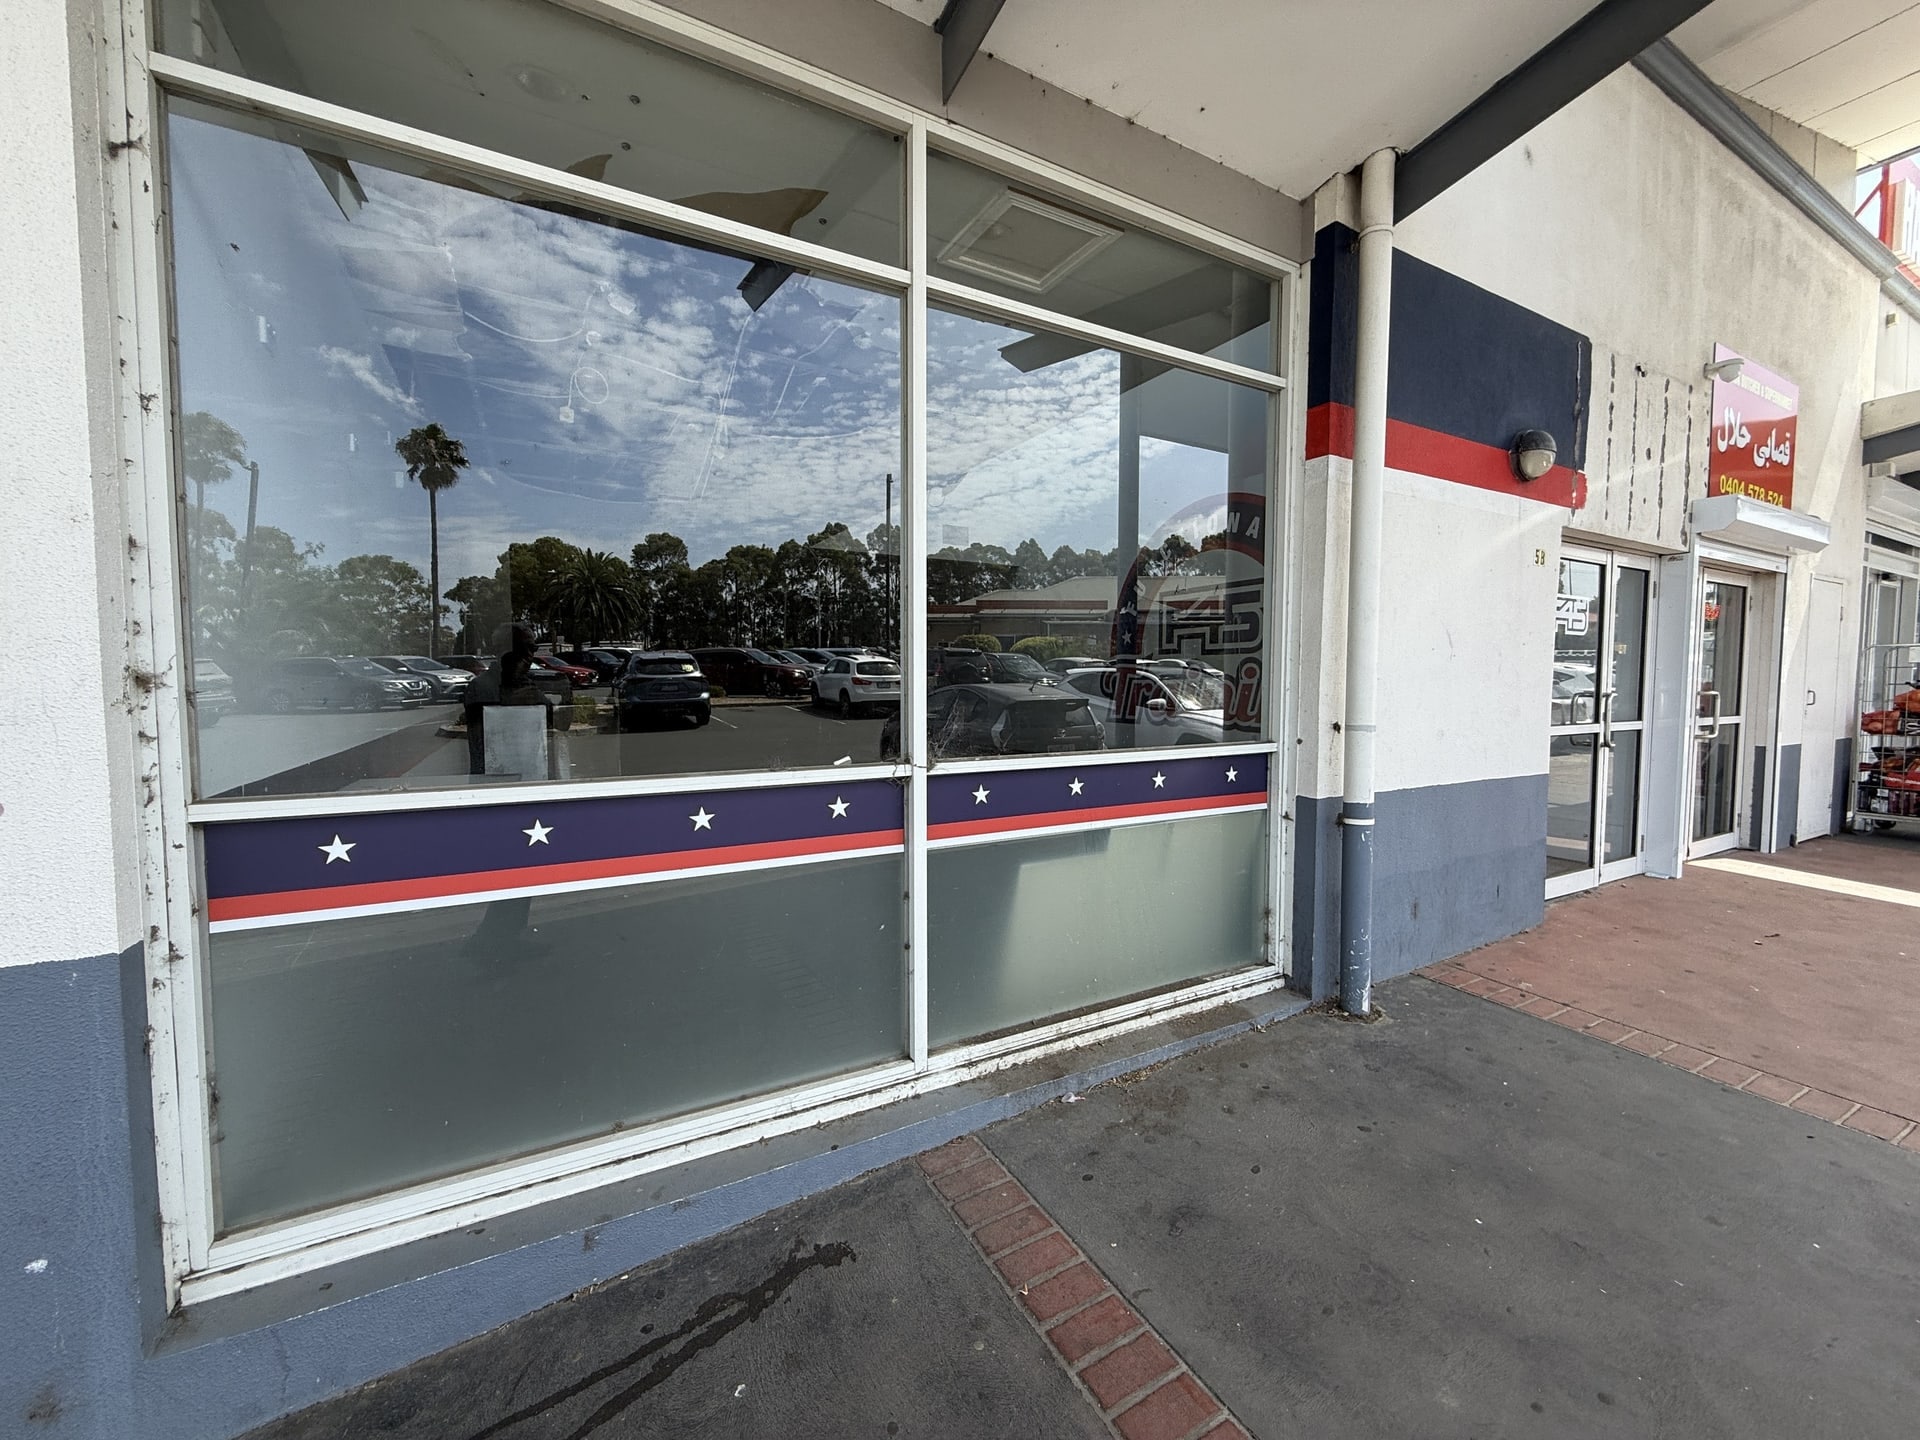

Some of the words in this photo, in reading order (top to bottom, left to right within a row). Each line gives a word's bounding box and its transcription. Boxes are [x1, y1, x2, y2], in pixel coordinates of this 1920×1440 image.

[1717, 406, 1752, 453] حلال
[1719, 474, 1745, 496] 0404
[1748, 483, 1766, 502] 578
